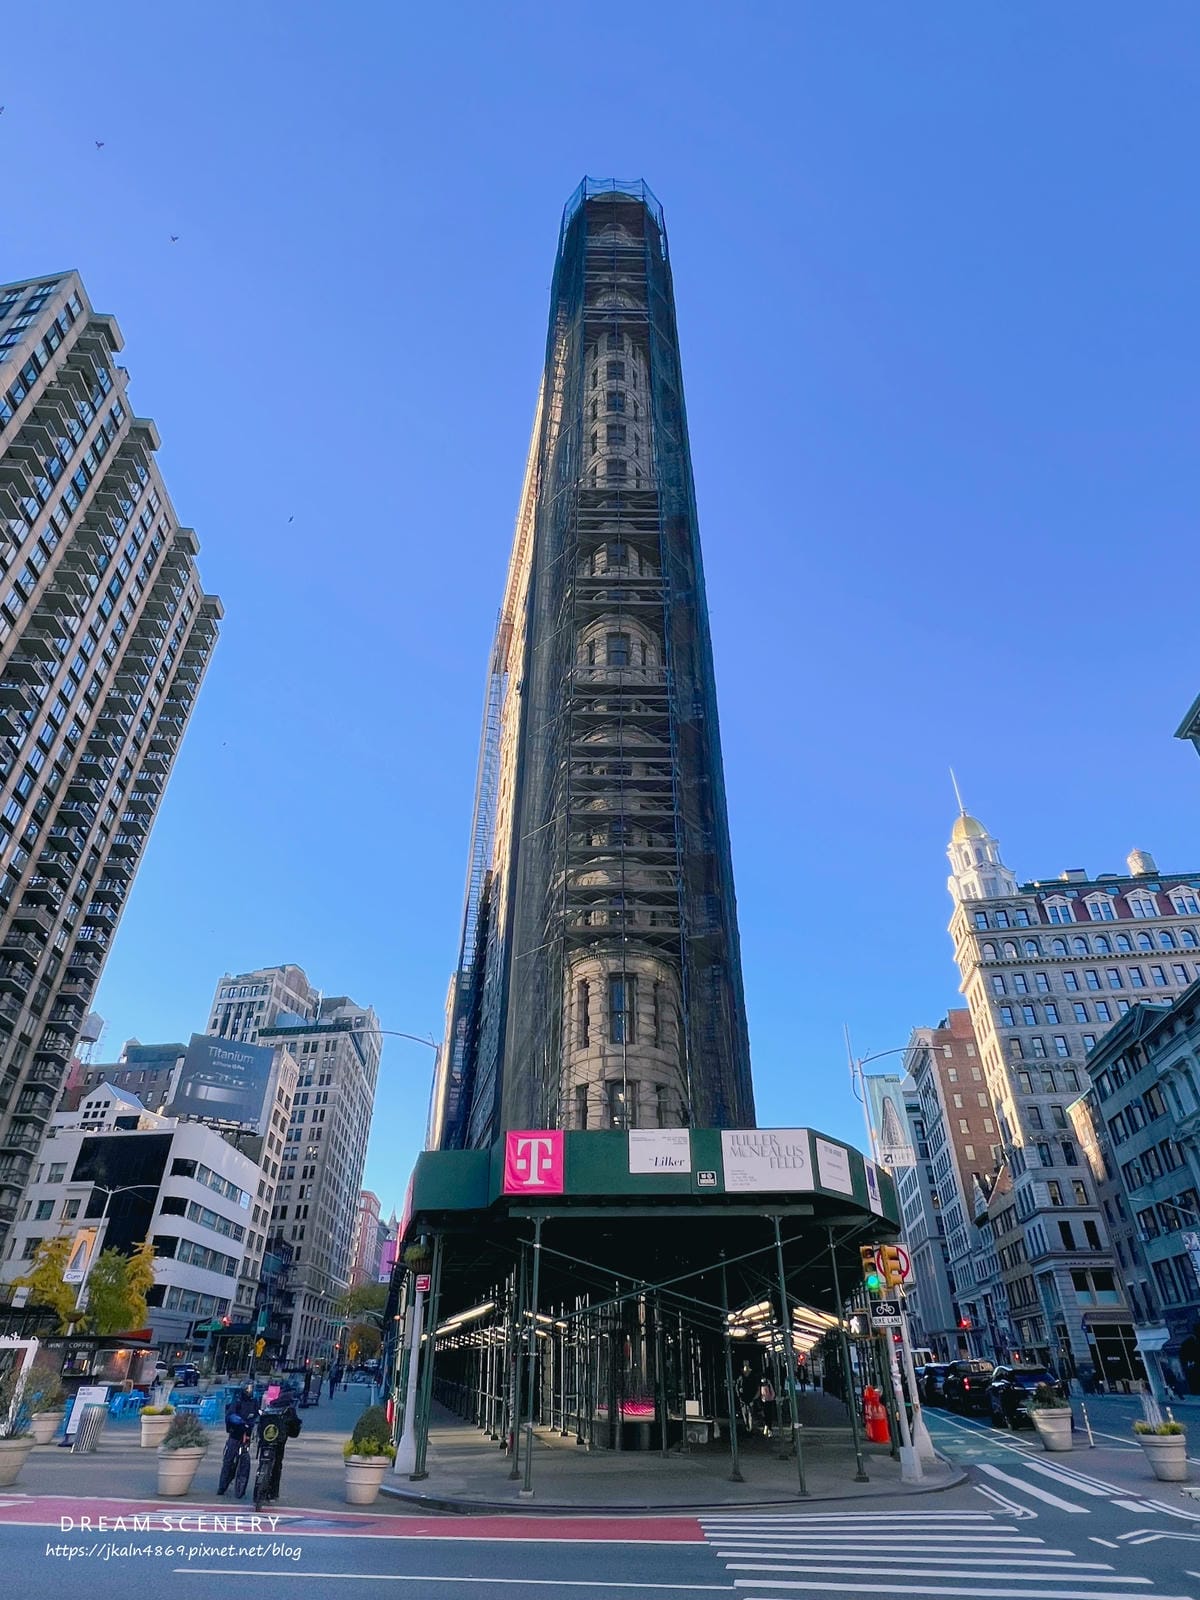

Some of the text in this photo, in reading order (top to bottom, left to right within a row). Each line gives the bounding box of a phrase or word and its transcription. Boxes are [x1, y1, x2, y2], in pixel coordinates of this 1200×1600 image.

[208, 1046, 254, 1064] Titanium
[730, 1134, 779, 1146] TULLER
[517, 1138, 552, 1185] T
[654, 1156, 685, 1167] Lilker
[873, 1317, 885, 1325] BIKE
